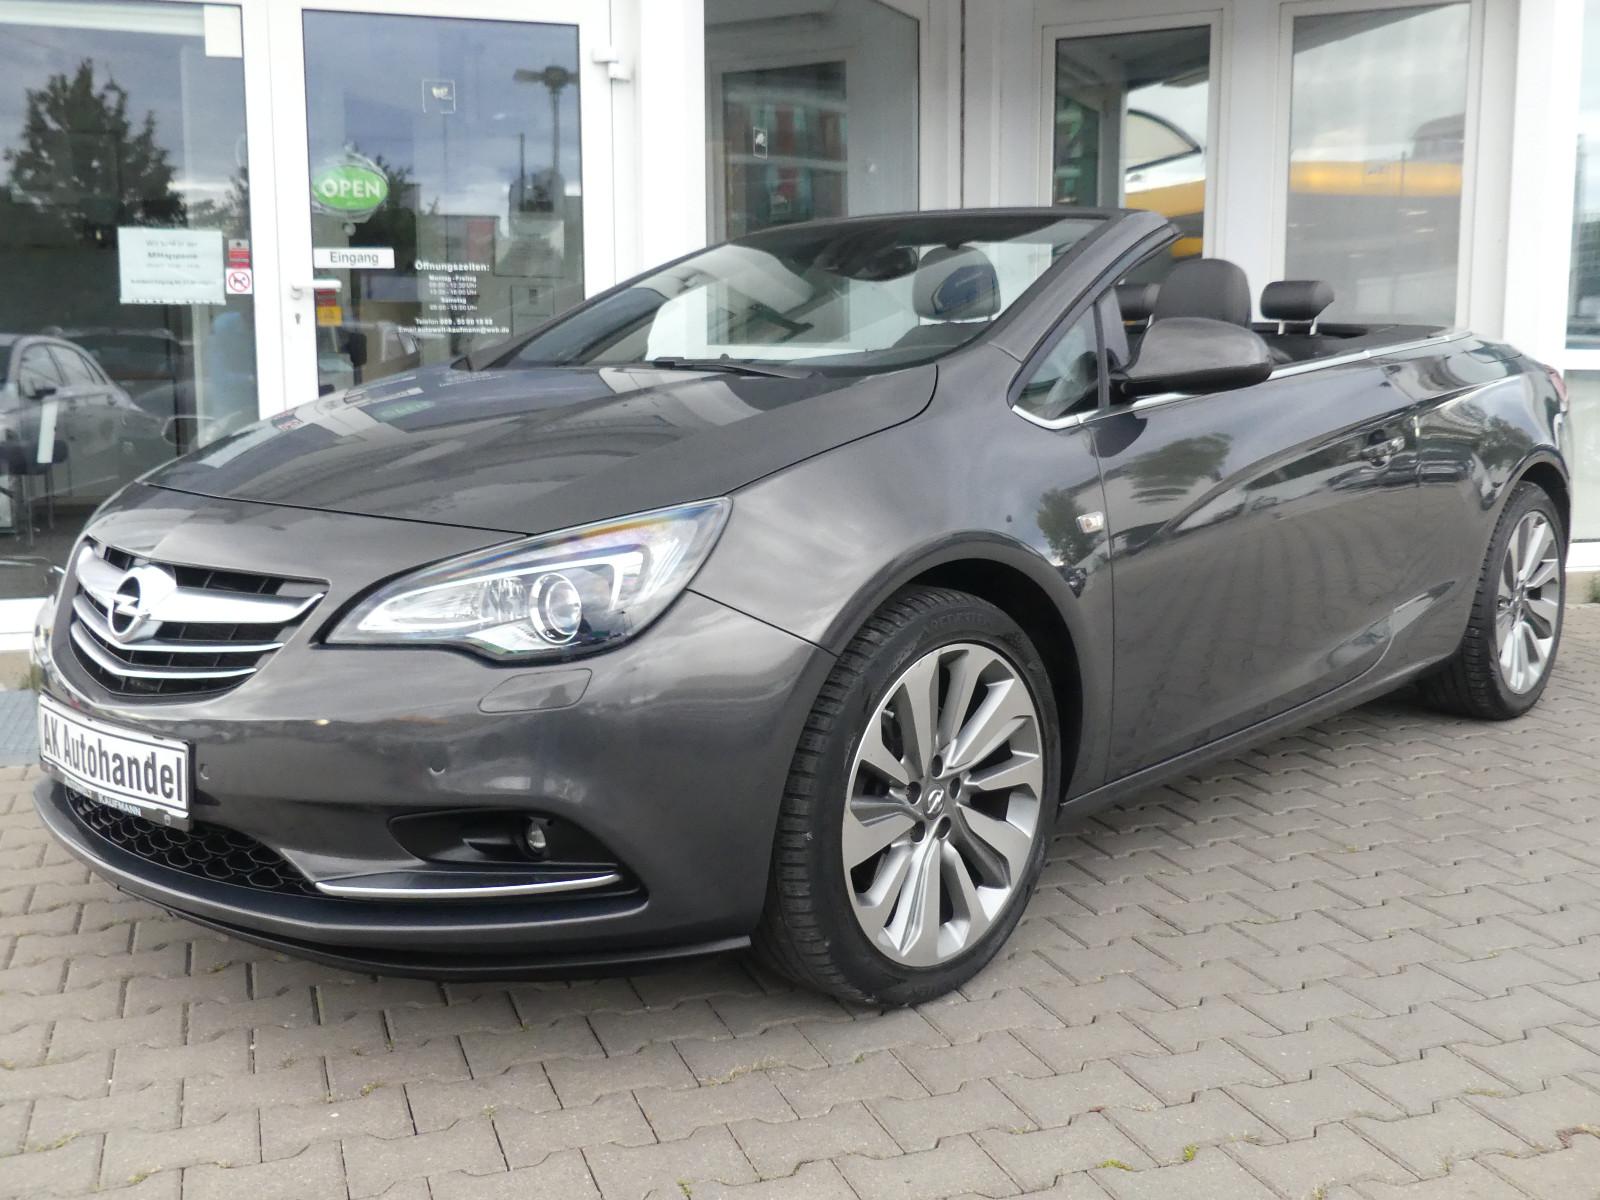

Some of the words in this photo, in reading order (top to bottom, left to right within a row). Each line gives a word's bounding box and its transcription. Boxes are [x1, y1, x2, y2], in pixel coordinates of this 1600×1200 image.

[320, 178, 381, 198] OPEN
[330, 251, 379, 266] Eingang
[414, 258, 490, 272] Öffnungszeiten:
[440, 297, 467, 305] Samstag
[44, 714, 61, 759] AK
[64, 724, 183, 802] Autohandel
